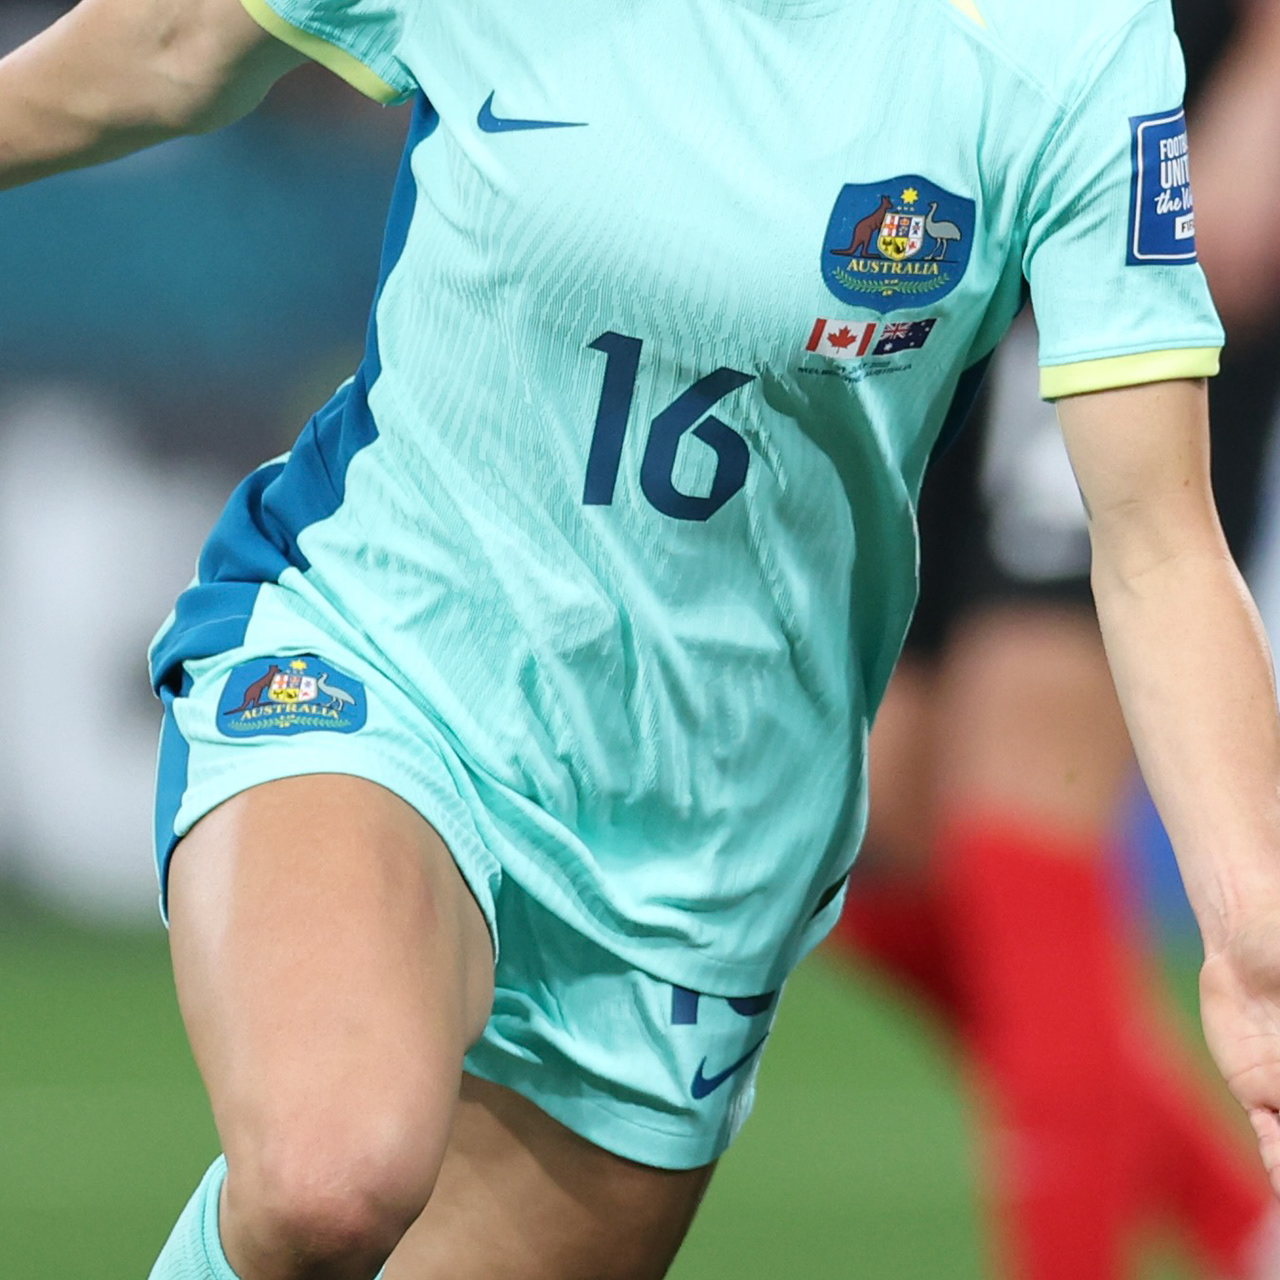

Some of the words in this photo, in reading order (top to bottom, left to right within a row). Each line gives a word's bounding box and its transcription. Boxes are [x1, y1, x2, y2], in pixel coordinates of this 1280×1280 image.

[1160, 156, 1190, 189] UNIT
[1154, 189, 1182, 216] the
[847, 258, 939, 275] AUSTRALIA
[582, 330, 757, 523] 16
[241, 703, 338, 720] AUSTRALIA
